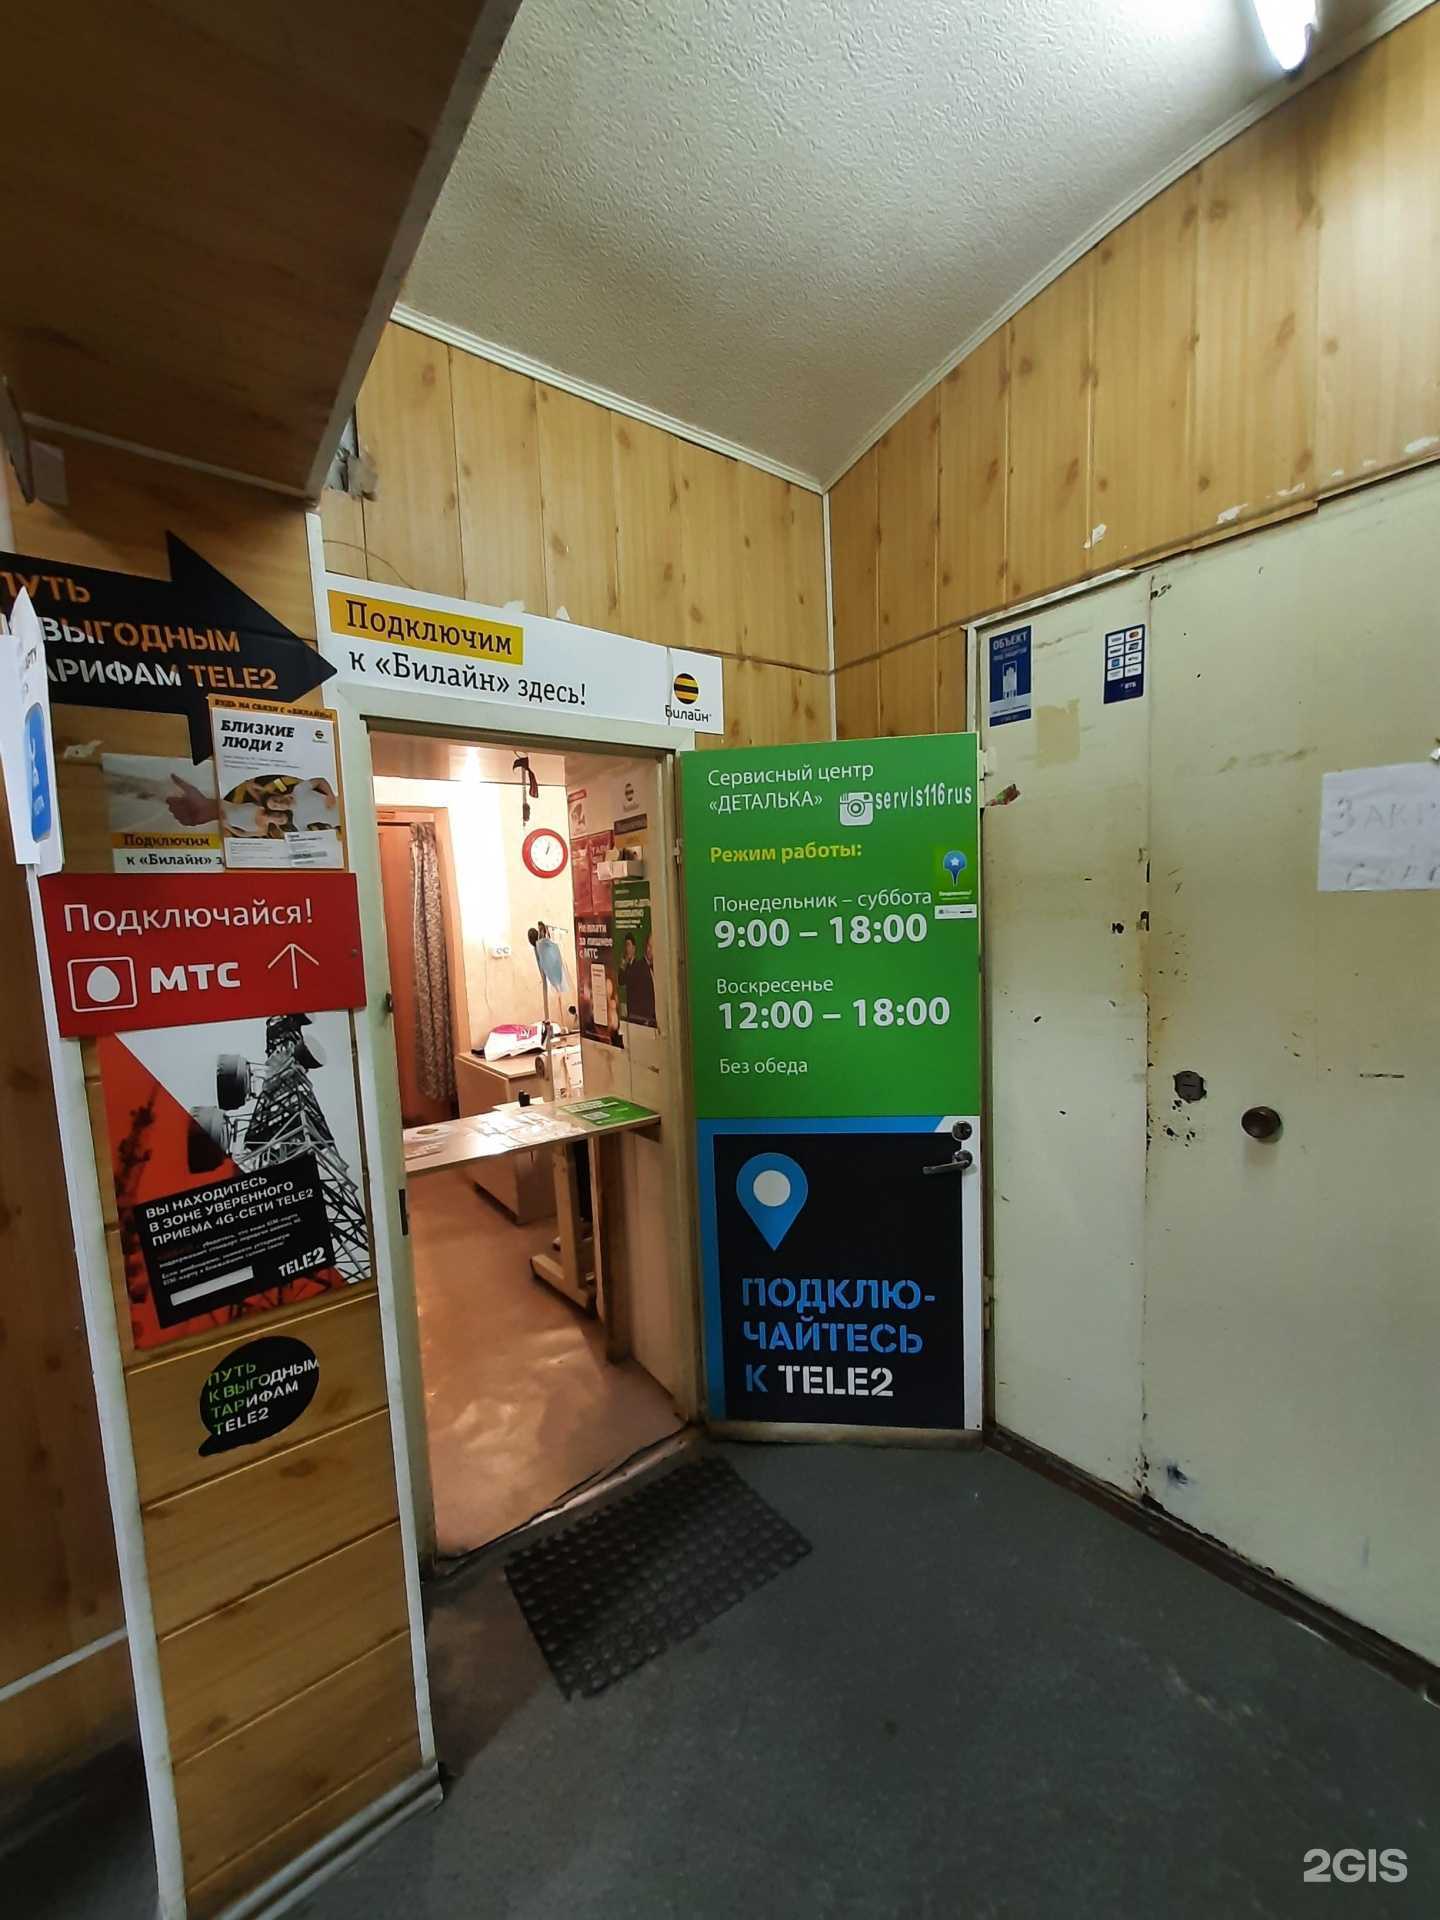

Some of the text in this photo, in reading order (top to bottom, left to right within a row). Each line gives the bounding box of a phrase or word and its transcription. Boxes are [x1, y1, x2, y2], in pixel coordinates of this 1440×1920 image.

[38, 616, 241, 653] ВЫГОДНЫМ
[345, 600, 512, 655] Подключим
[188, 664, 279, 690] TELE2
[349, 651, 587, 706] к «Билайн» здесь!
[220, 719, 295, 738] БЛИЗКИЕ
[222, 736, 284, 752] ЛЮДИ 2
[708, 764, 874, 788] Сервисный центр
[709, 790, 823, 815] «ДЕТАЛЬКА»
[124, 834, 210, 848] Подключим
[710, 842, 863, 863] Режим работы:
[127, 856, 136, 865] к
[713, 893, 838, 913] Понедельник
[857, 887, 932, 910] суббота
[63, 897, 314, 937] Подключайся!
[714, 919, 790, 948] 9:00
[829, 913, 928, 945] 18:00
[716, 979, 834, 999] Воскресенье
[718, 1000, 813, 1030] 12:00
[853, 996, 951, 1027] 18:00
[719, 1057, 808, 1076] Без обеда
[145, 1175, 267, 1219] ВЫ НАХОДИТЕСЬ
[149, 1180, 294, 1233] В ЗОНЕ УВЕРЕННОГО
[152, 1220, 213, 1247] ПРИЕМА
[276, 1188, 314, 1208] TELE2
[278, 1246, 327, 1278] TELE2
[742, 1278, 936, 1314] ПОДКЛЮ-
[743, 1315, 924, 1354] ЧАЙТЕСЬ
[207, 1362, 257, 1387] ПУТЬ
[209, 1359, 320, 1404] К ВЫГОДНЫМ
[746, 1364, 894, 1397] К TELE2
[211, 1380, 299, 1419] ТАРИФАМ
[213, 1407, 270, 1436] TELE2
